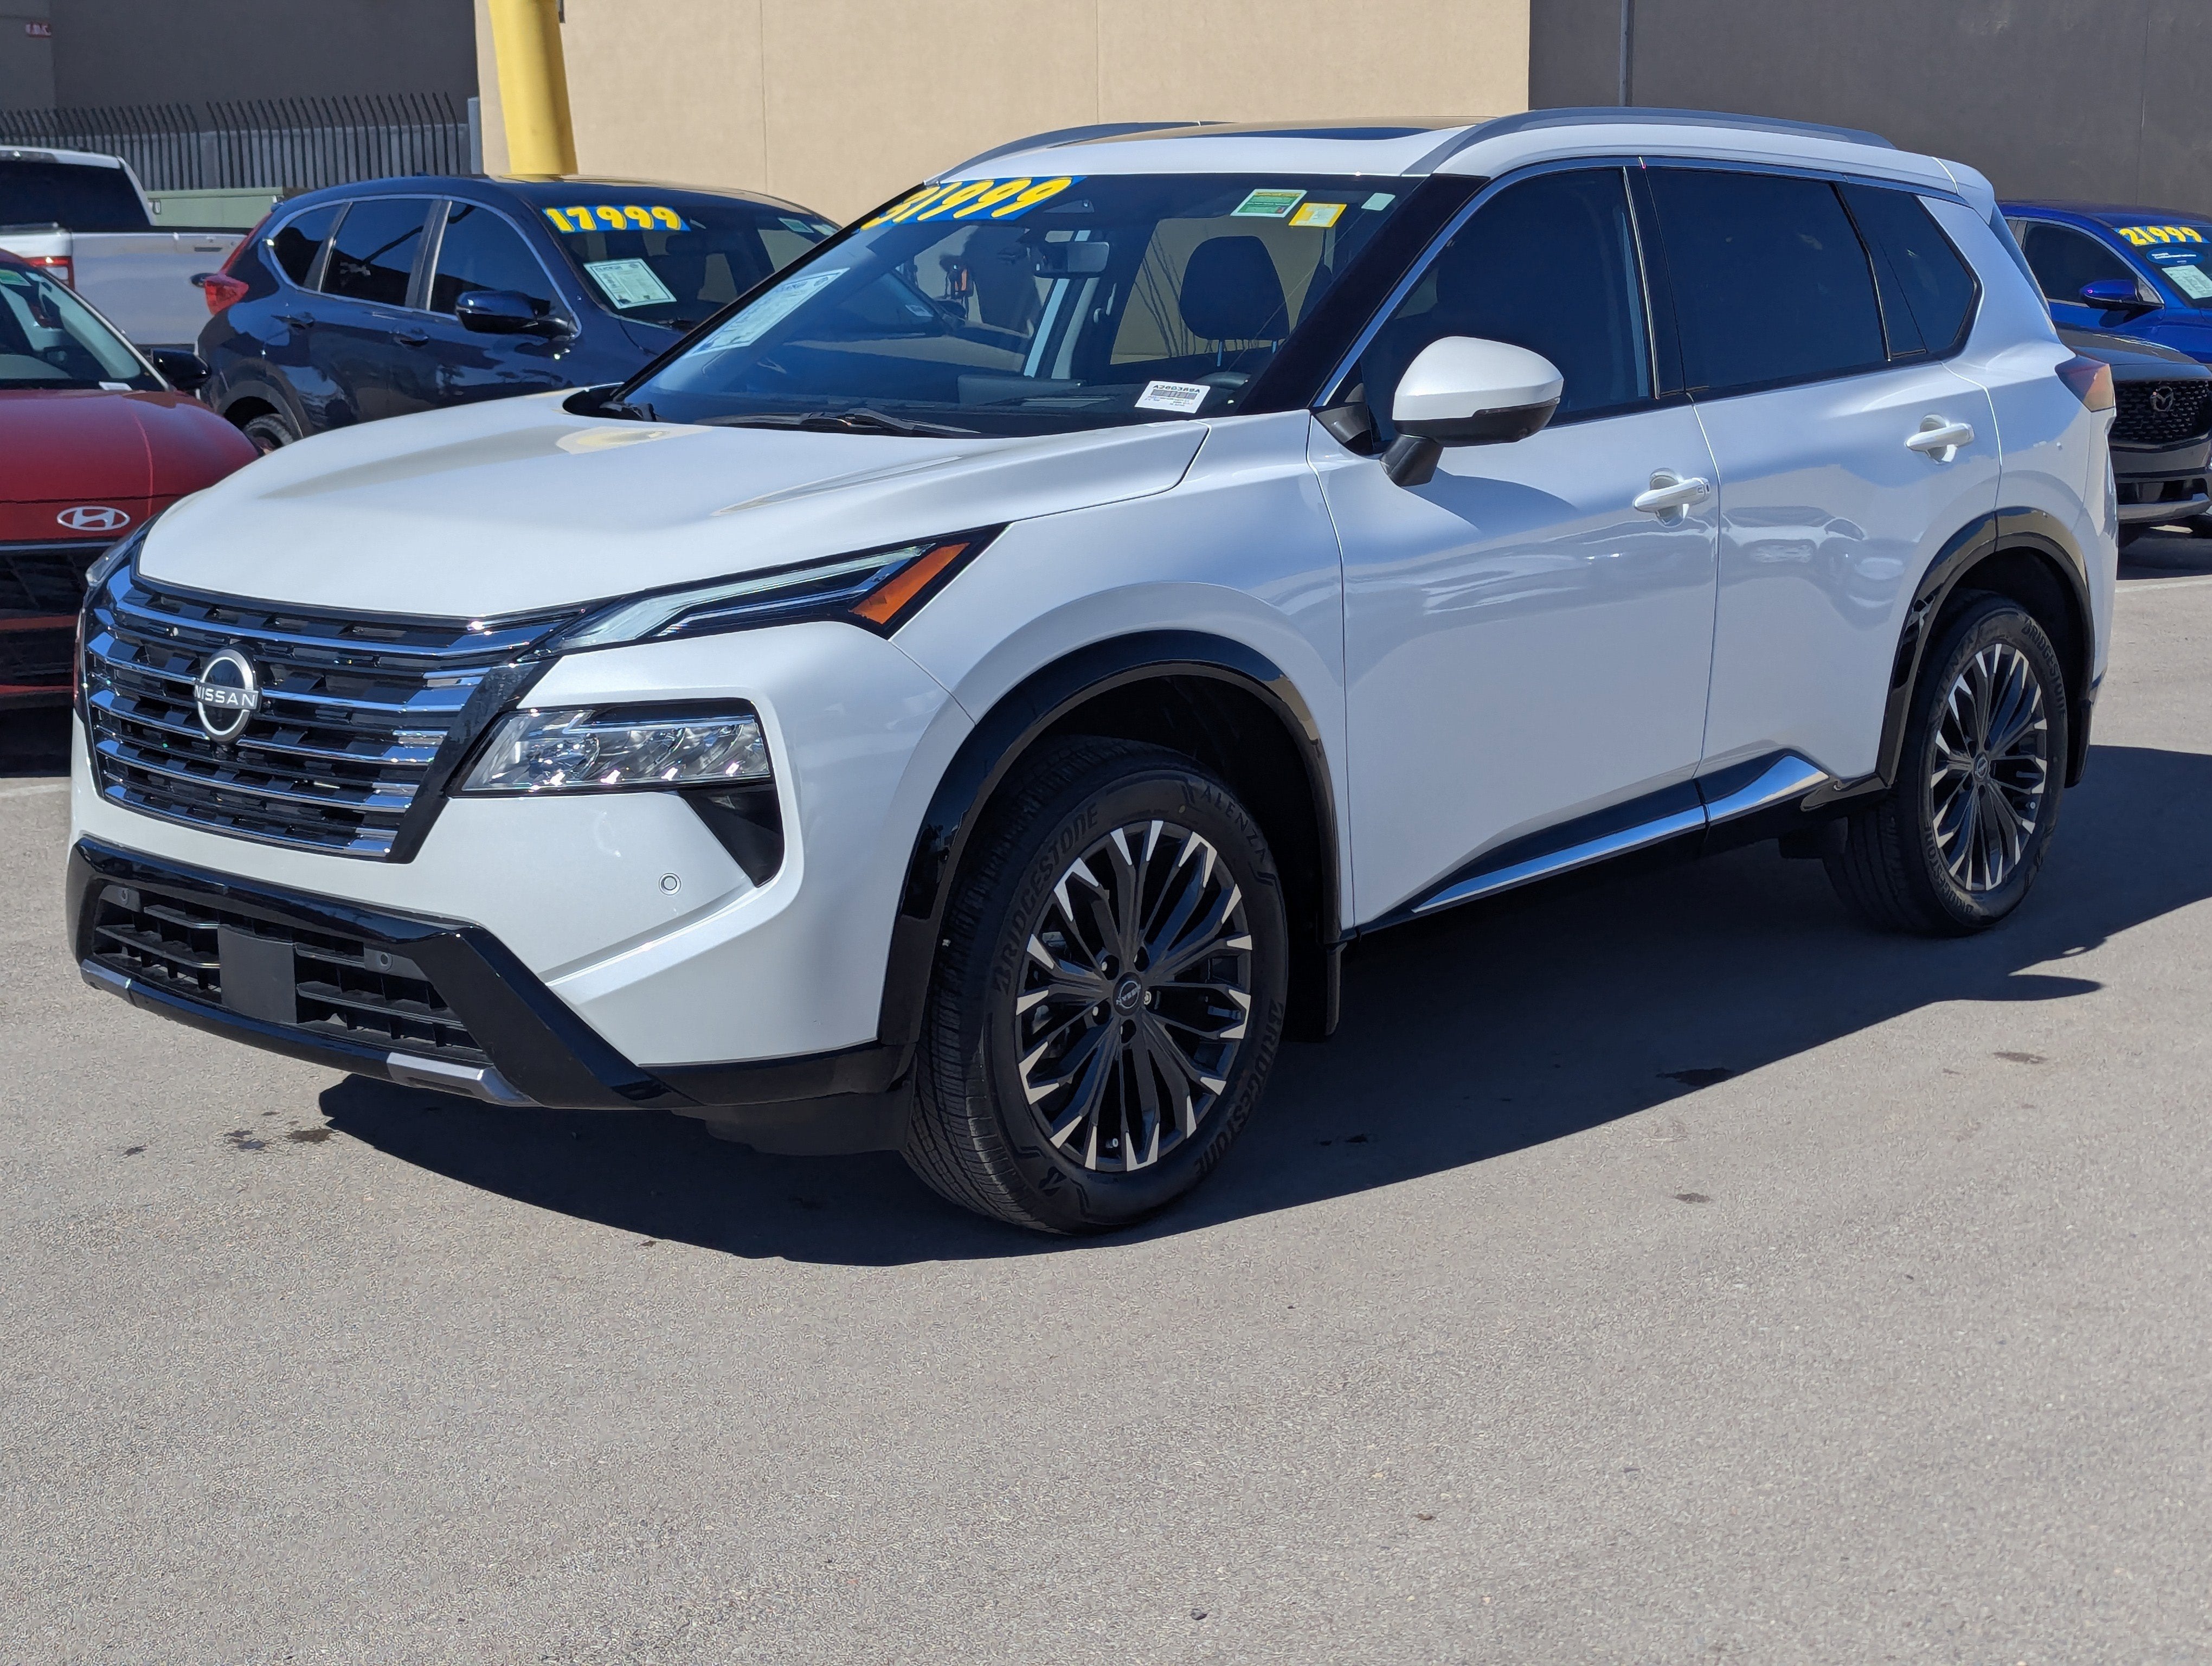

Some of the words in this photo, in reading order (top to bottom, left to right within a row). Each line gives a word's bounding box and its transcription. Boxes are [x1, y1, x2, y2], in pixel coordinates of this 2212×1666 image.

[545, 205, 681, 232] 17999
[860, 176, 1072, 231] 31999
[2119, 226, 2202, 246] 21999
[194, 684, 256, 707] NISSAN
[1200, 785, 1266, 864] ALENZA
[992, 802, 1099, 997] BRIDGESTONE
[1193, 999, 1285, 1175] BRIDGESTONE
